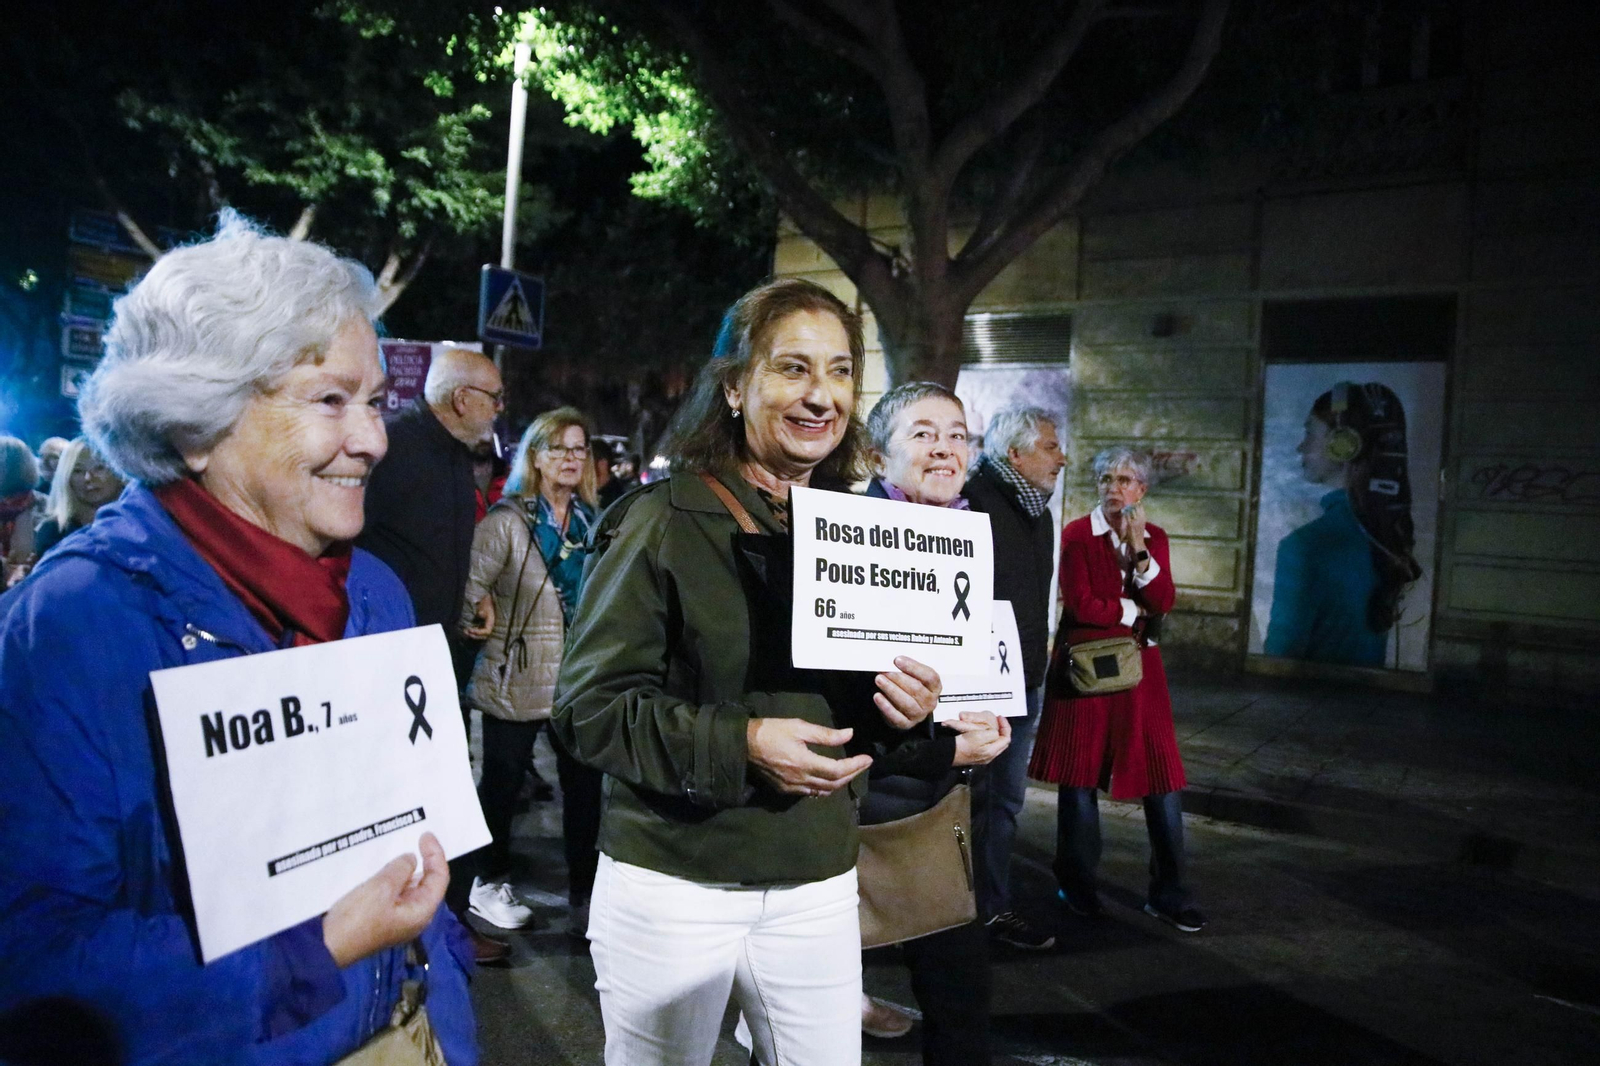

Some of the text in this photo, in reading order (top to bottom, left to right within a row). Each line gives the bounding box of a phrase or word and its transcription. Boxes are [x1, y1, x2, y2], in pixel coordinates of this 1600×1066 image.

[815, 517, 974, 558] Rosa del Carmen
[815, 557, 940, 594] Pous Escrivá,
[814, 598, 855, 620] 66 años
[832, 629, 865, 639] asesinada
[866, 631, 877, 640] por
[877, 632, 888, 640] sus
[889, 632, 910, 642] vecinos
[930, 636, 934, 644] y
[934, 635, 954, 645] Antonio
[200, 695, 358, 758] Noa B., 7 años
[274, 846, 322, 875] asesinada
[321, 841, 337, 857] por
[337, 837, 349, 851] su
